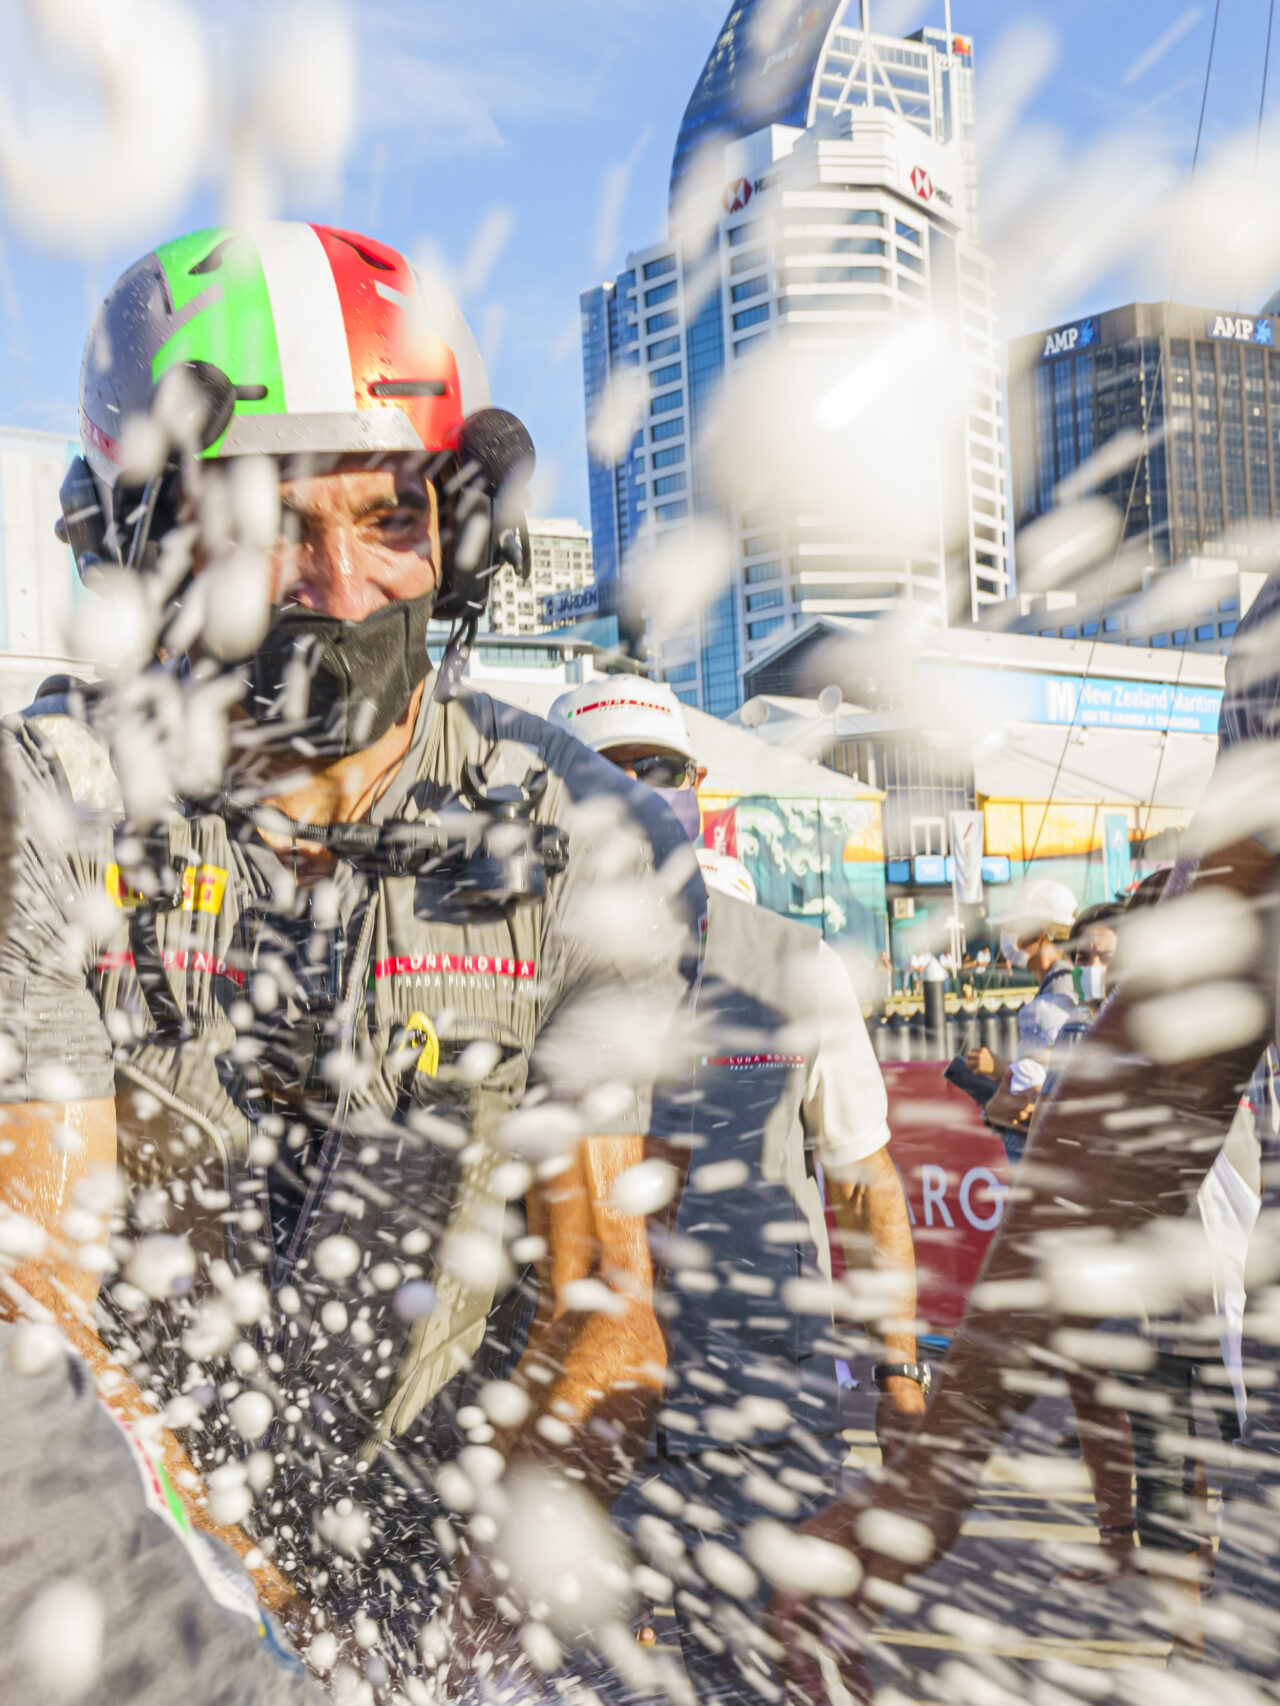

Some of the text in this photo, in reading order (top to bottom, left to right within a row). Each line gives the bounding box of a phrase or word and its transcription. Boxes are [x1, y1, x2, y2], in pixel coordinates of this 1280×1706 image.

[1213, 316, 1254, 340] AMP
[1045, 327, 1079, 356] AMP
[1080, 684, 1112, 706] New
[1113, 685, 1168, 710] Zealand
[1170, 691, 1220, 713] Maritim
[396, 955, 530, 975] LUNA ROSSA
[397, 975, 441, 988] PRADA
[729, 1053, 802, 1064] LUNA ROSSA
